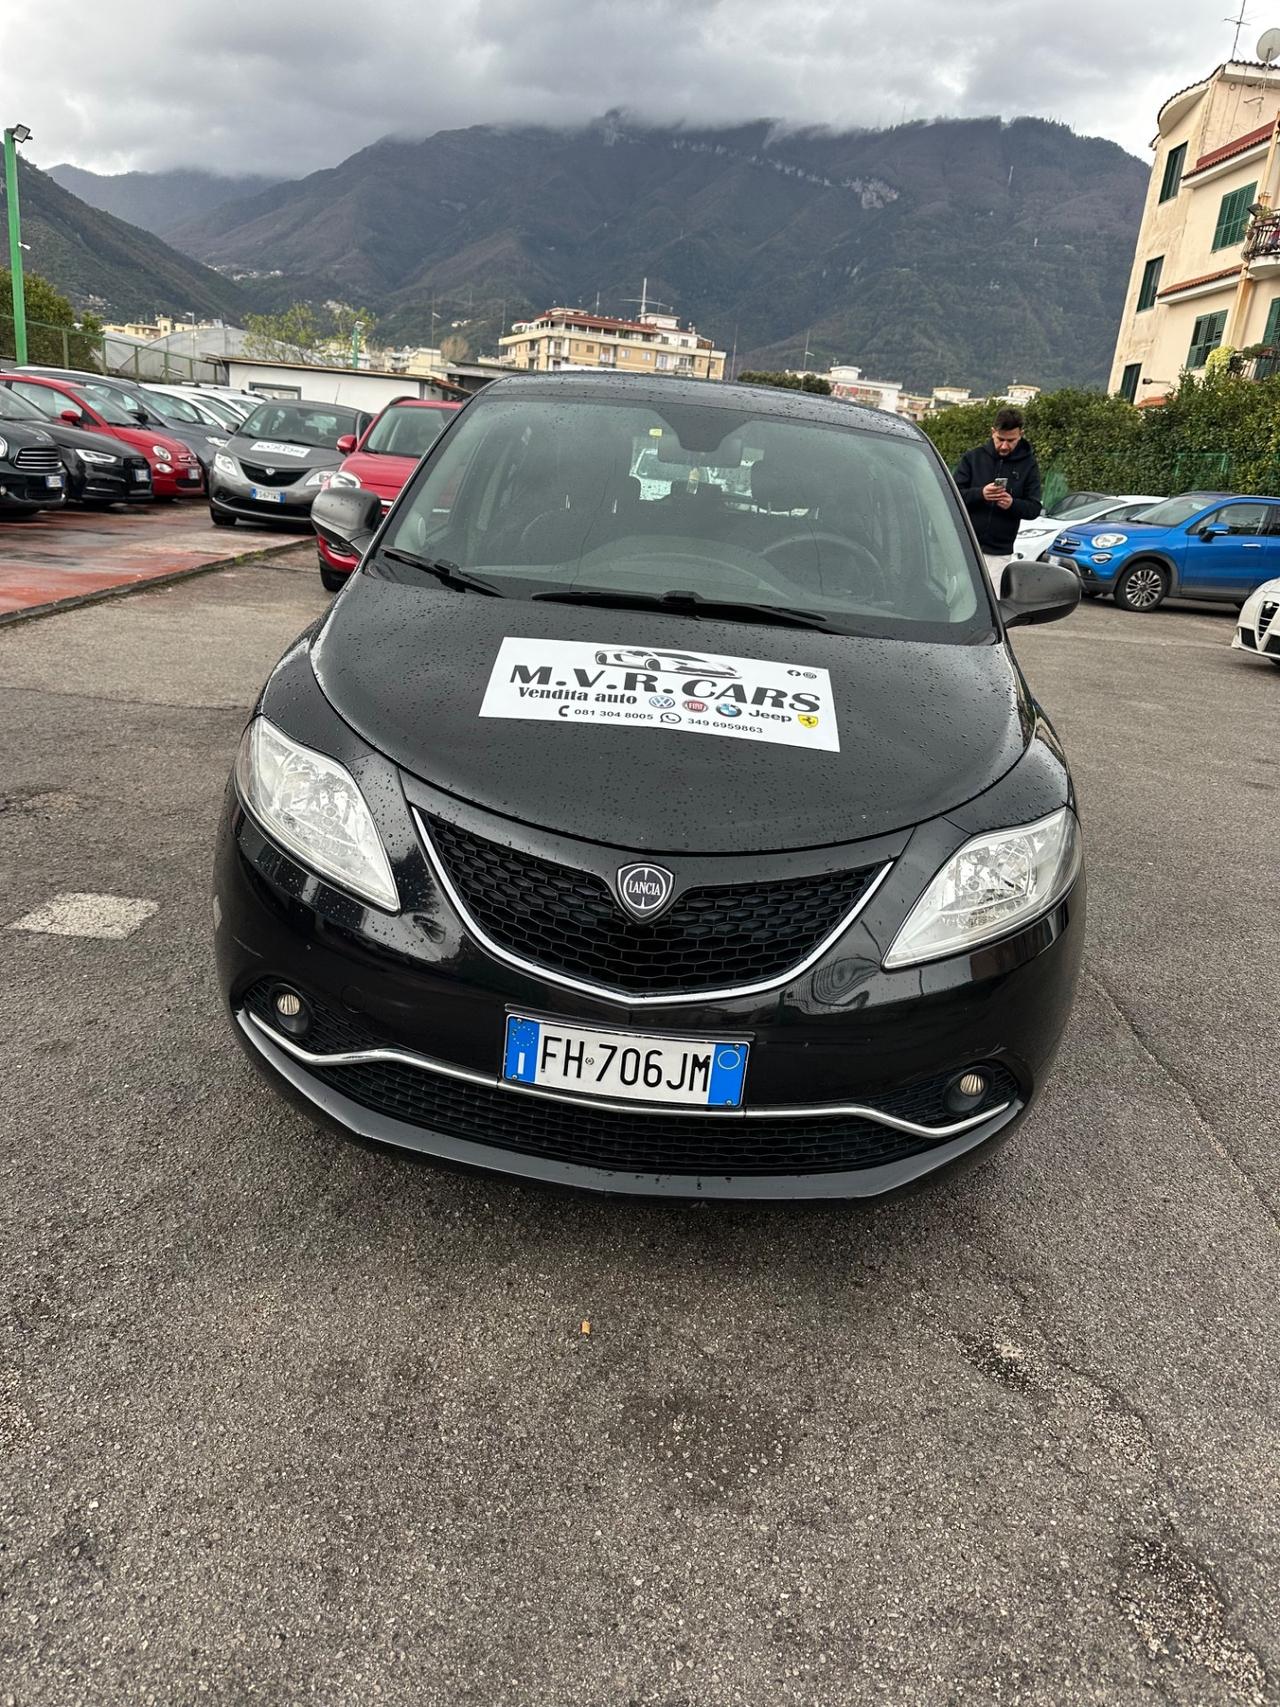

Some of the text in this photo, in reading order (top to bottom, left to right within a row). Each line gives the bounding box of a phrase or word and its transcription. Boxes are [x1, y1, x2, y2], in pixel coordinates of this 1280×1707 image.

[519, 686, 638, 705] Vendita auto
[574, 708, 654, 720] 081 304 8005
[749, 710, 793, 723] Jeep
[688, 717, 710, 727] 349
[628, 880, 661, 896] LANCIA
